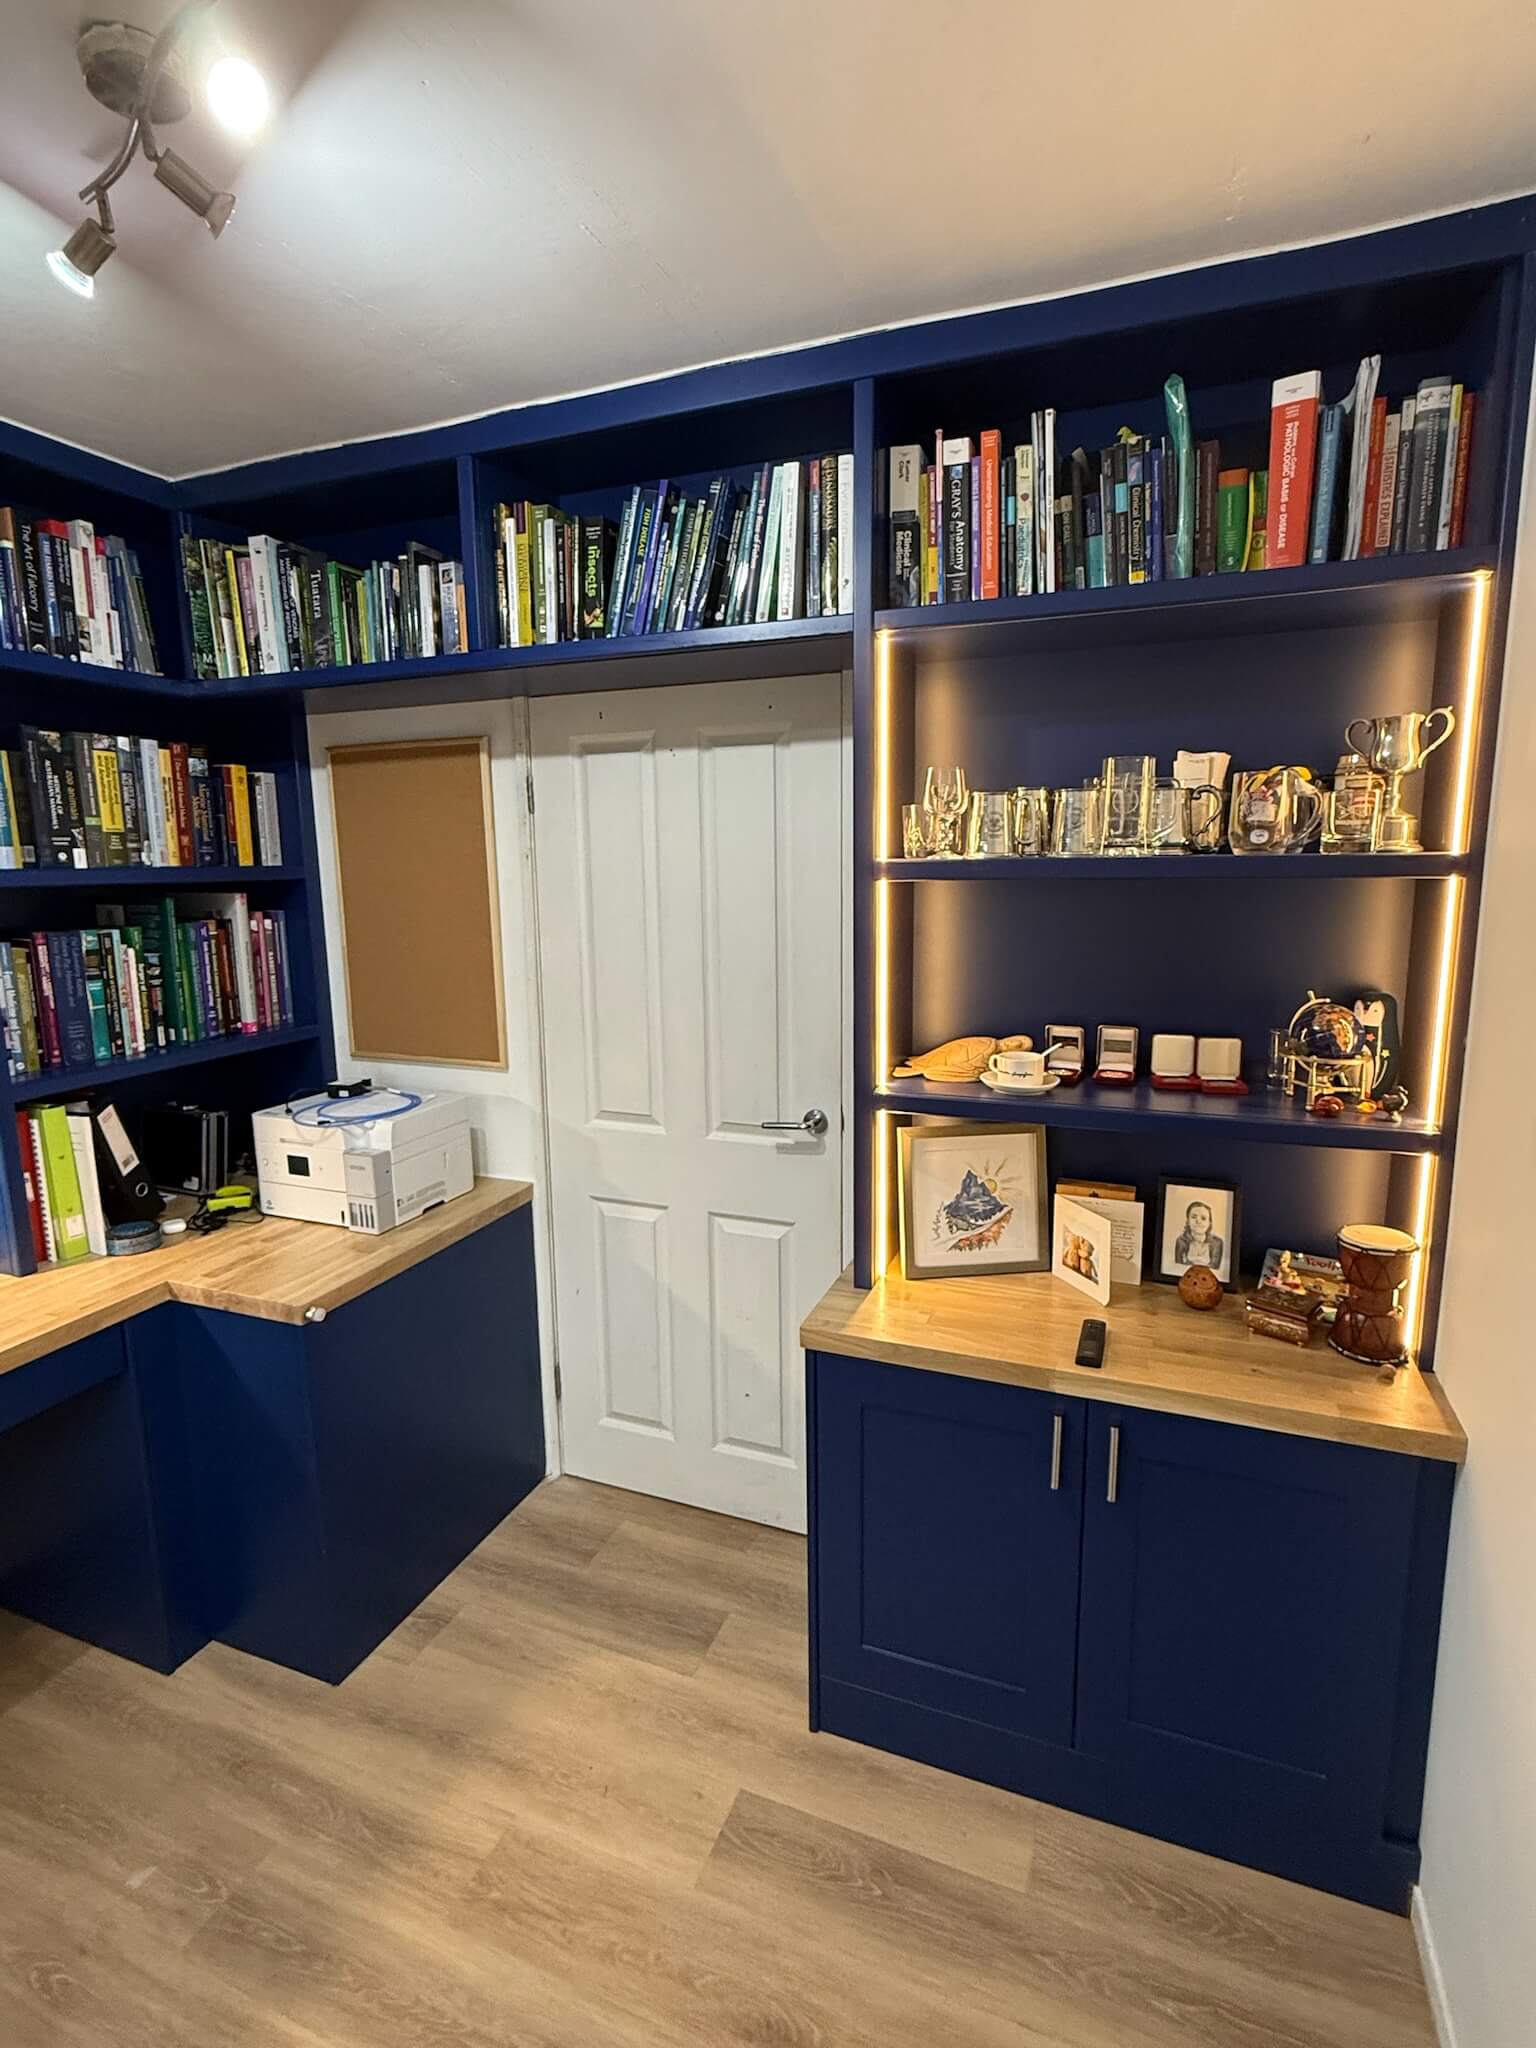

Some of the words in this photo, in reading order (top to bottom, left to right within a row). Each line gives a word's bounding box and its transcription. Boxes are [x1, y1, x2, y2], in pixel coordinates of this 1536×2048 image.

[1281, 422, 1294, 476] PATHOLOGIC
[984, 459, 993, 508] Understanding
[1280, 478, 1290, 503] BASIS
[1381, 455, 1395, 499] STATISTICS
[642, 508, 652, 525] FISH
[757, 498, 767, 514] The
[839, 482, 850, 535] Evolution
[951, 480, 962, 519] GRAY'S
[1131, 487, 1141, 518] Clinical
[20, 525, 31, 542] The
[985, 509, 993, 535] Medical
[1130, 519, 1143, 561] Chemistry
[1277, 513, 1288, 549] DISEASE
[1378, 501, 1391, 546] EXPLAINED
[22, 542, 34, 559] Art
[637, 526, 649, 557] DISEASE
[895, 531, 904, 575] Medicine
[902, 530, 913, 567] Clinical
[953, 520, 967, 570] Anatomy
[1017, 518, 1027, 569] Paediatrics
[25, 561, 36, 572] of
[586, 546, 599, 598] Insects
[26, 572, 39, 612] Falconry
[310, 569, 322, 619] Tuatara
[65, 770, 74, 786] zoo
[67, 787, 79, 820] animals
